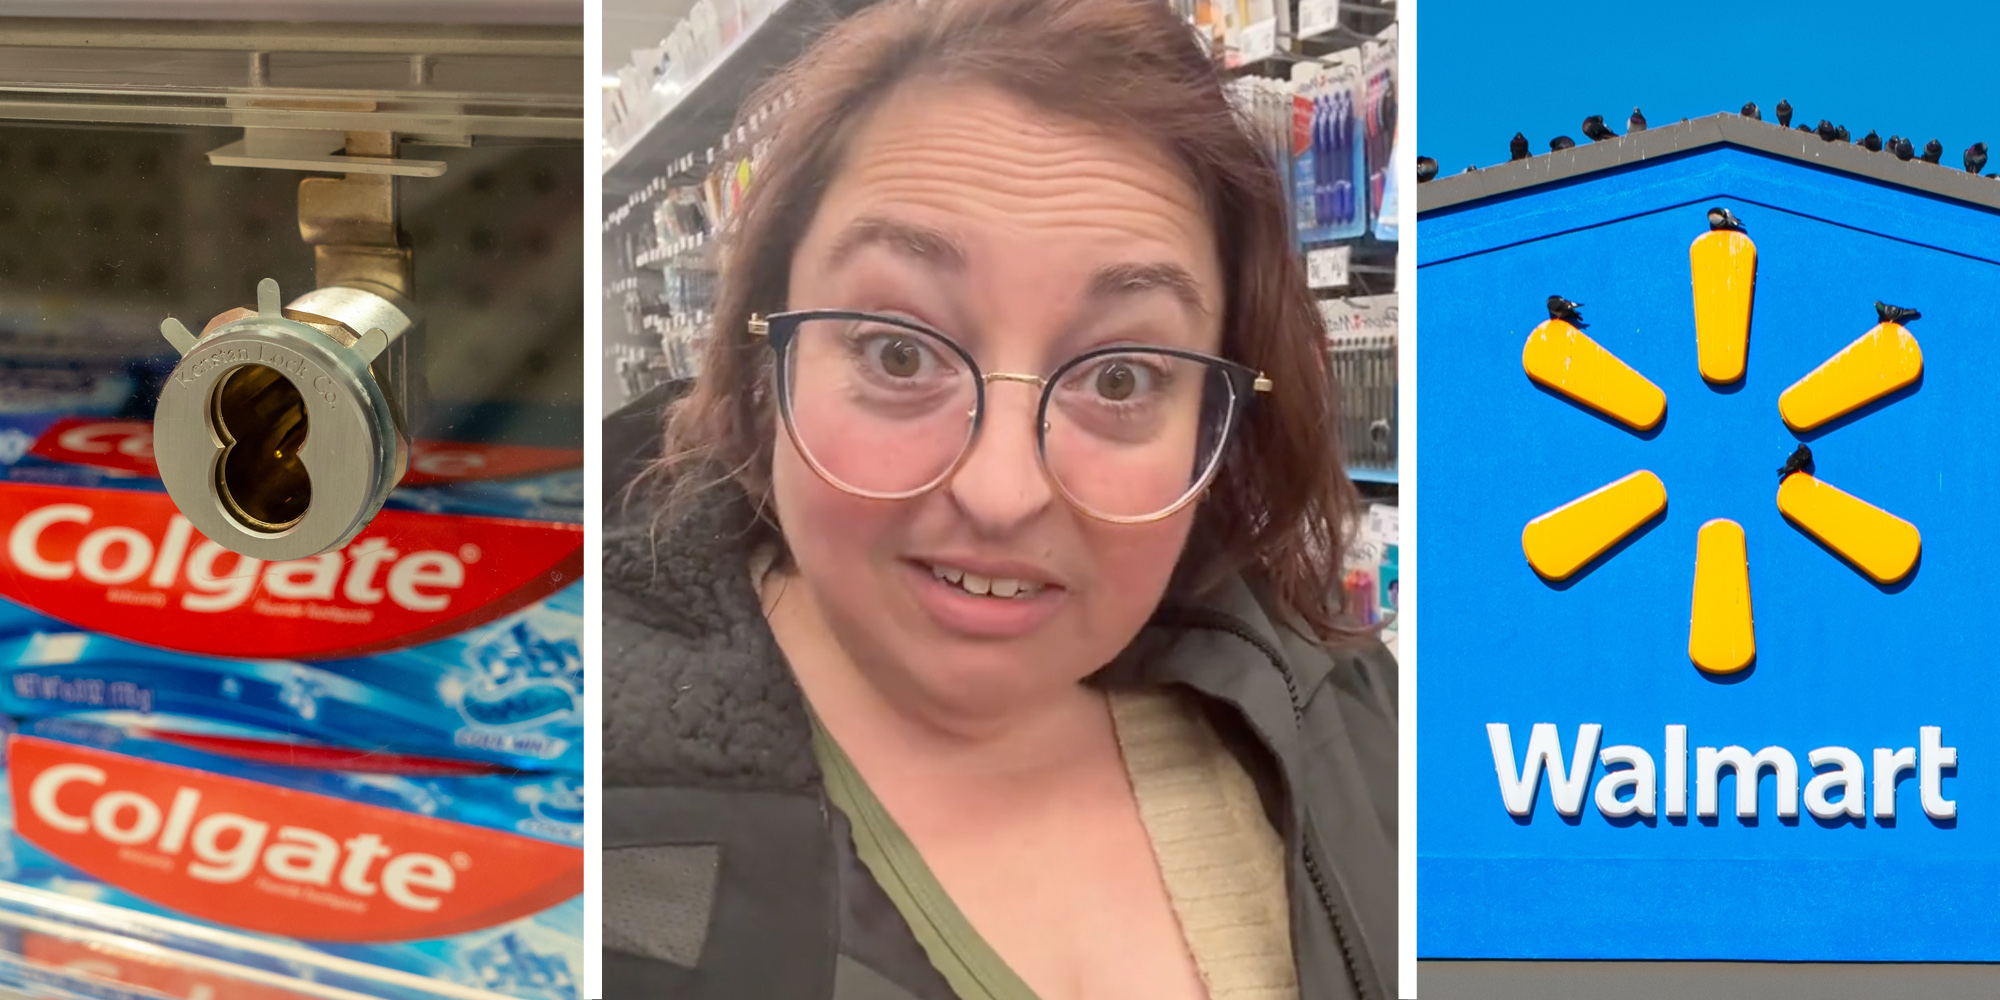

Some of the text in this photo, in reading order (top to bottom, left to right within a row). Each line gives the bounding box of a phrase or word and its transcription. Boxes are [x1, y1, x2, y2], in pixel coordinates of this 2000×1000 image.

[173, 342, 338, 410] Kenstan Lock Co.
[8, 503, 464, 613] Colgate
[1485, 722, 1958, 819] Walmart
[28, 763, 456, 912] Colgate
